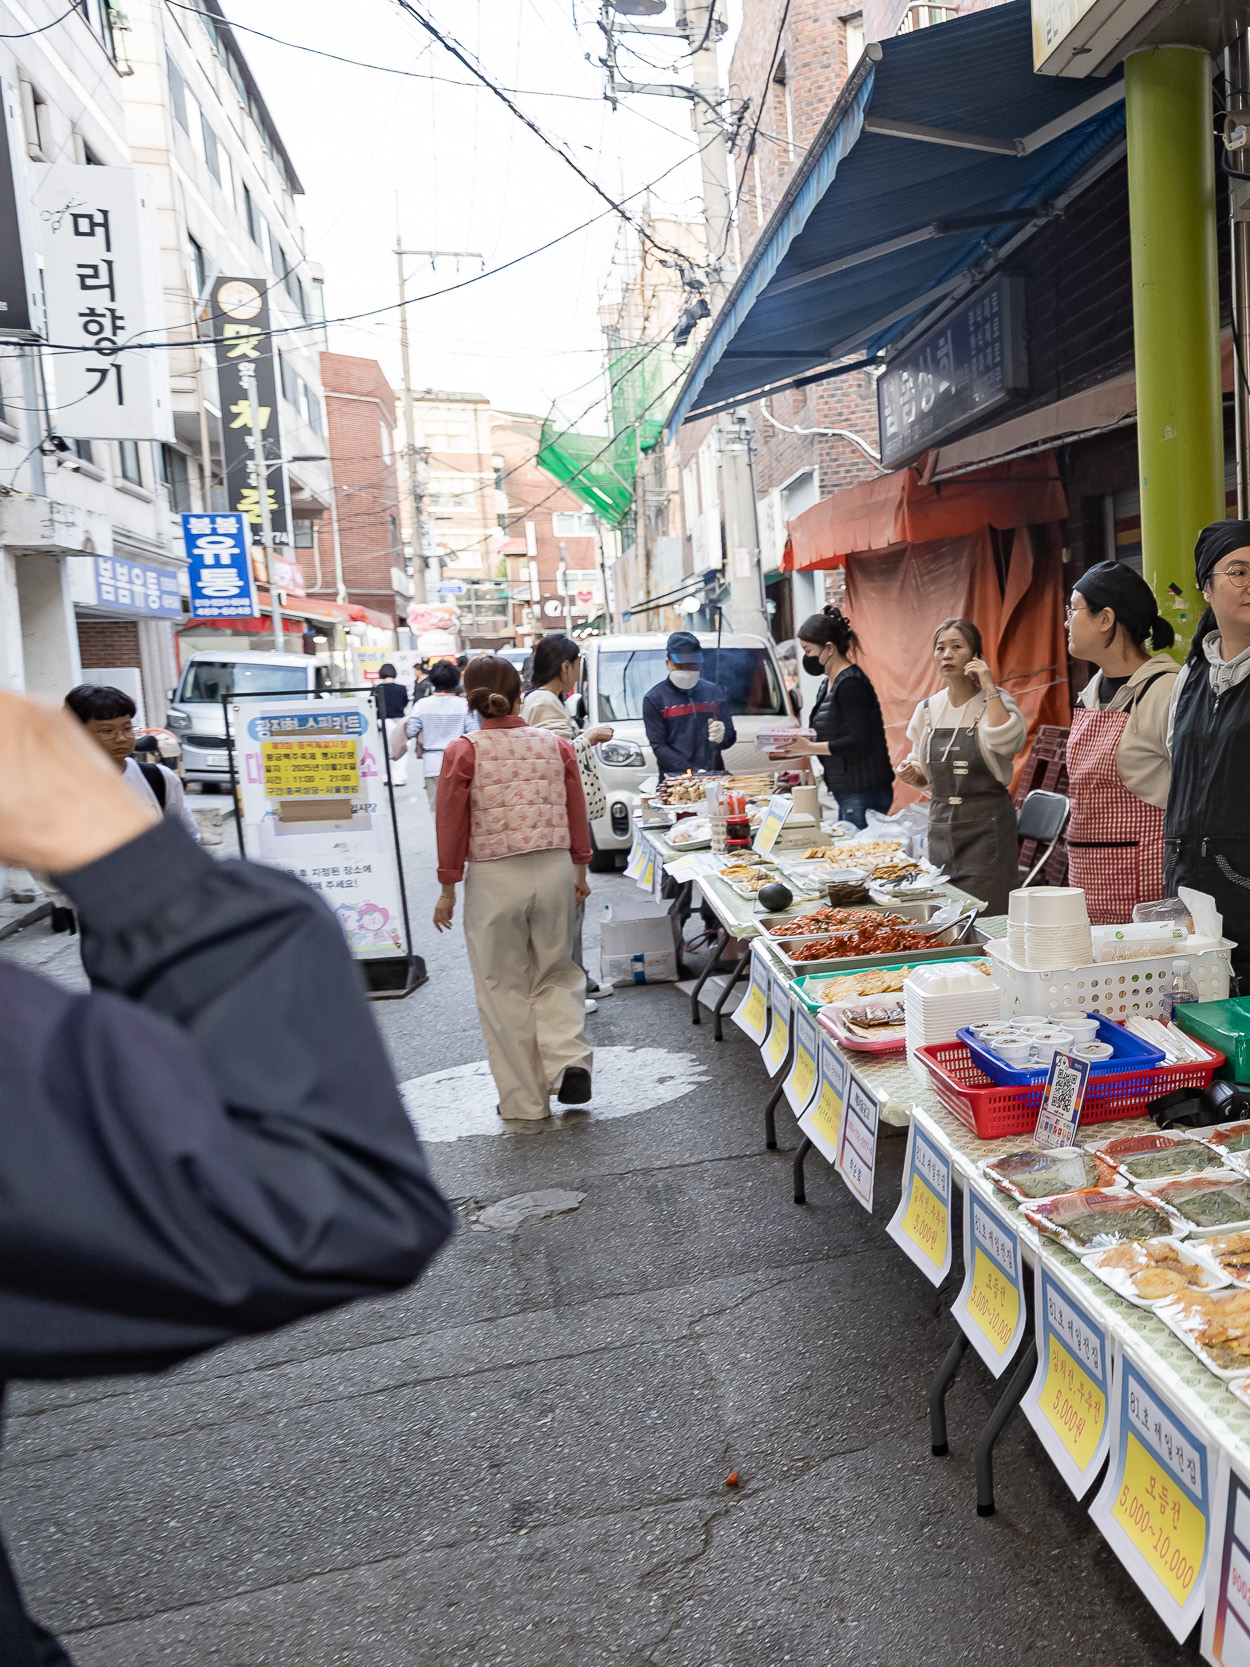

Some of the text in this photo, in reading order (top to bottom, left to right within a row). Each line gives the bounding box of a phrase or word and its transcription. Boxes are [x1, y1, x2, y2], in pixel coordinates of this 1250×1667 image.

[69, 208, 126, 406] 머리향기
[192, 534, 245, 597] 유통
[311, 867, 341, 877] 지정된
[343, 864, 372, 876] 장소에
[325, 879, 359, 890] 주세요!
[985, 1272, 1006, 1308] 모듬전
[1052, 1388, 1086, 1444] 5,000원
[1144, 1475, 1182, 1532] 모듬전
[1118, 1484, 1194, 1590] 5,000~10,000
